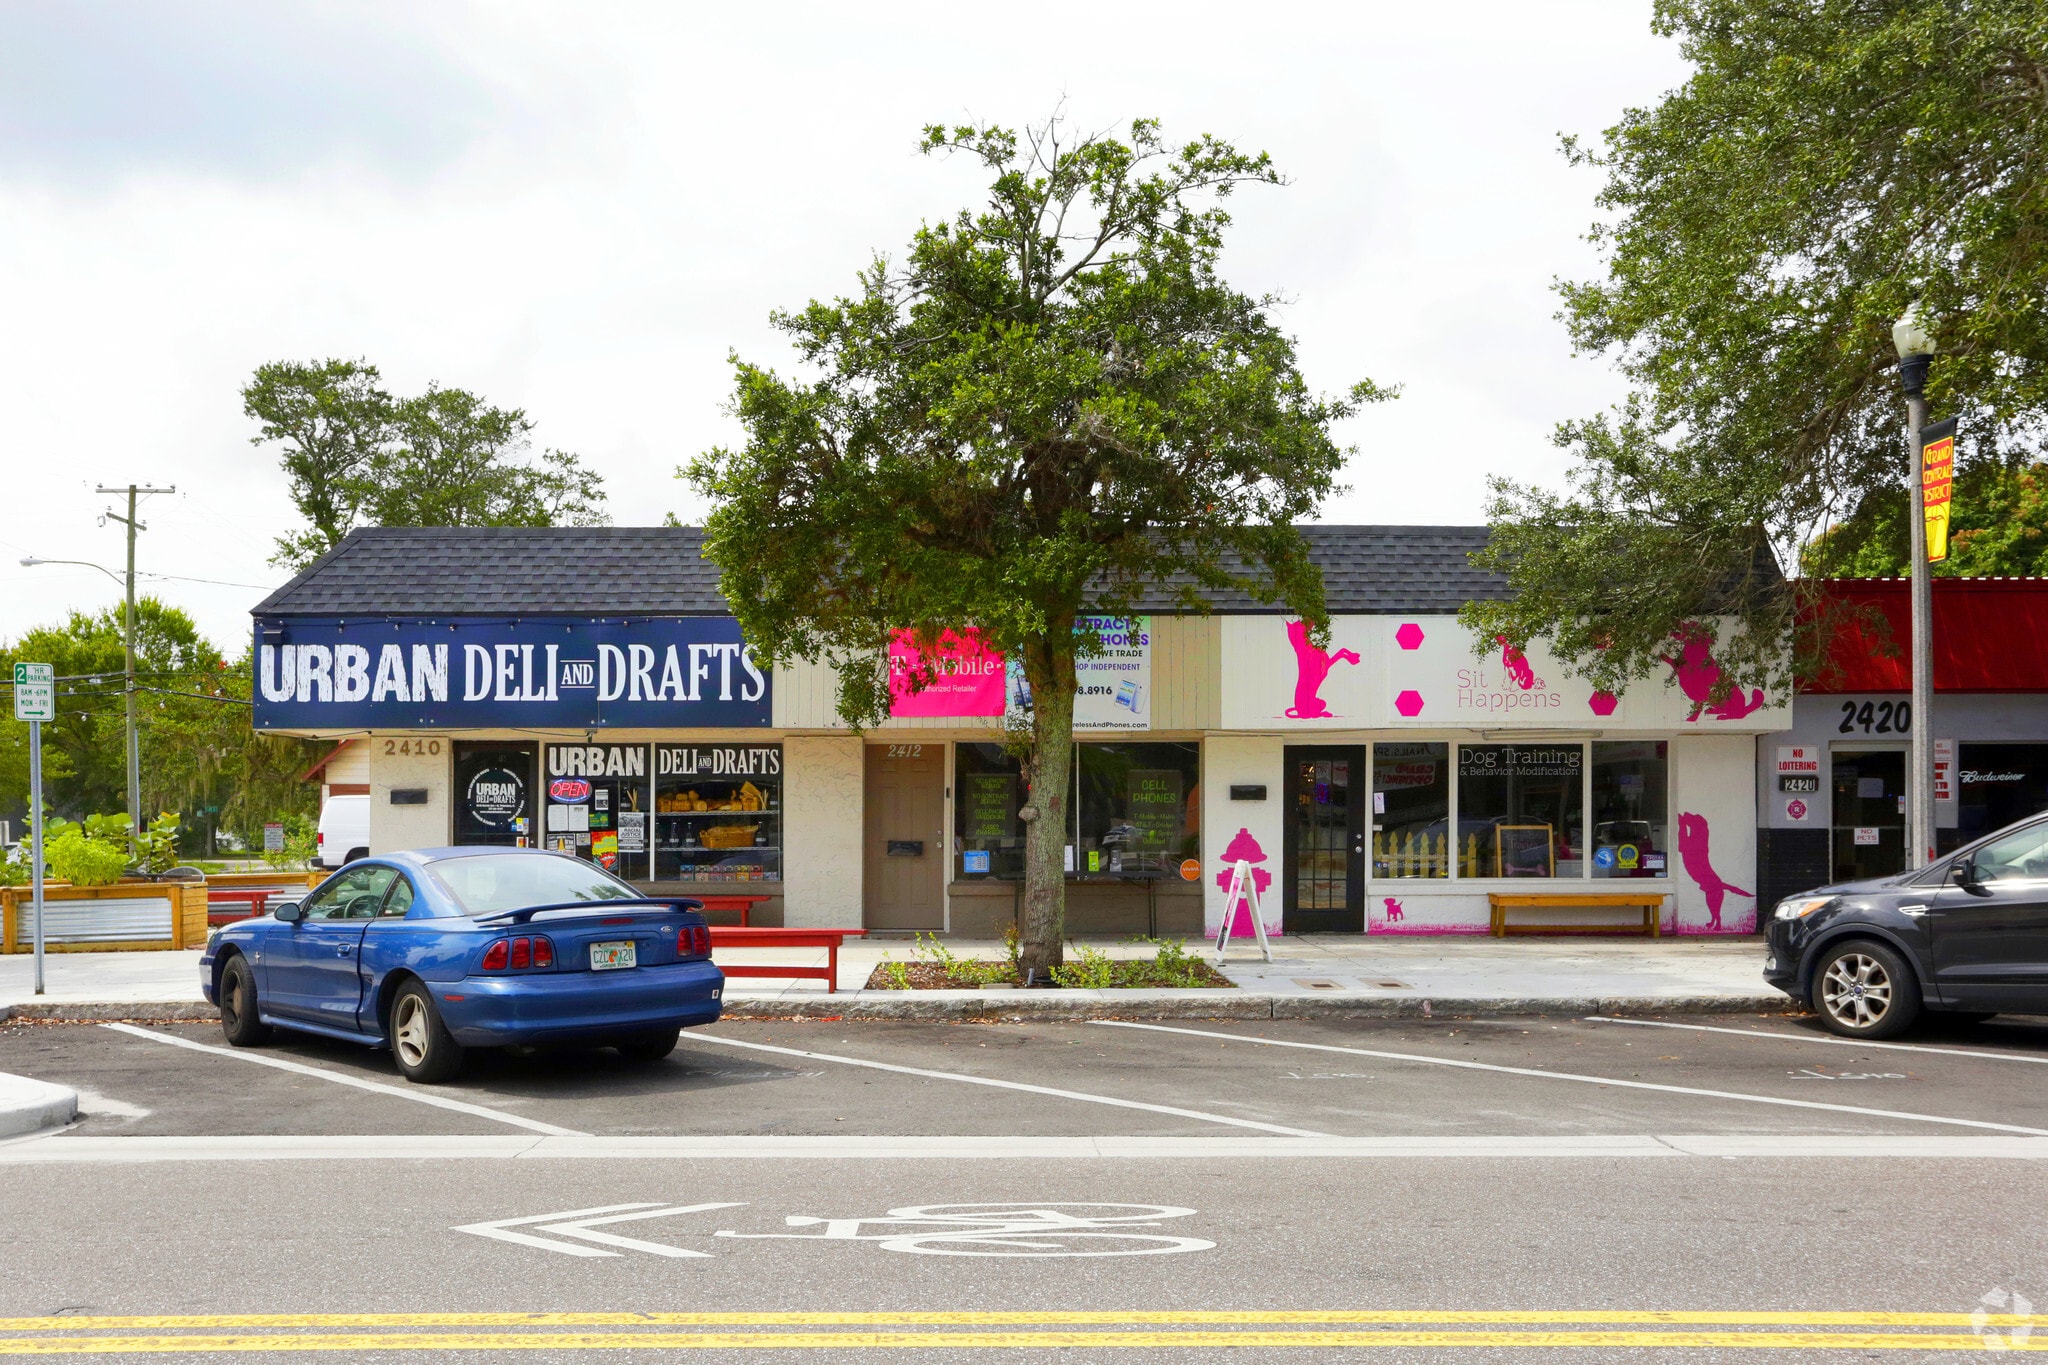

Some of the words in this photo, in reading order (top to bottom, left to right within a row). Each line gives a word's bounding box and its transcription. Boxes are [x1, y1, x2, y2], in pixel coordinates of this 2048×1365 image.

[1926, 448, 1951, 465] GRAND
[1100, 634, 1149, 646] HONS
[17, 667, 25, 682] 2
[28, 674, 51, 682] PARKING
[260, 644, 448, 703] URBAN
[463, 644, 559, 701] DELI
[561, 664, 594, 685] AND
[597, 643, 765, 702] DRAFTS
[1457, 669, 1488, 688] Sit
[39, 699, 49, 707] FRI
[1457, 689, 1561, 712] Happens
[1839, 701, 1912, 734] 2420
[1072, 721, 1148, 729] relessAndPhones.com
[385, 739, 441, 756] 2410
[888, 744, 922, 757] 2412
[1793, 749, 1803, 758] NO
[549, 747, 644, 777] URBAN
[659, 749, 698, 774] DELI
[698, 757, 712, 767] AND
[712, 749, 780, 774] DRAFTS
[1460, 749, 1498, 767] Dog
[1501, 749, 1581, 767] Training
[1460, 767, 1467, 776] &
[1469, 767, 1513, 776] Behavior
[1516, 767, 1578, 776] Modification
[1779, 762, 1817, 771] LOITERING
[1959, 771, 2026, 783] Budweiser
[476, 783, 516, 795] URBAN
[550, 783, 590, 796] OPEN
[1142, 780, 1168, 790] CELL
[1786, 779, 1816, 791] 2420
[476, 795, 490, 803] DELI
[493, 795, 516, 803] DRAFTS
[1133, 793, 1177, 804] PHONES
[618, 948, 634, 962] X20
